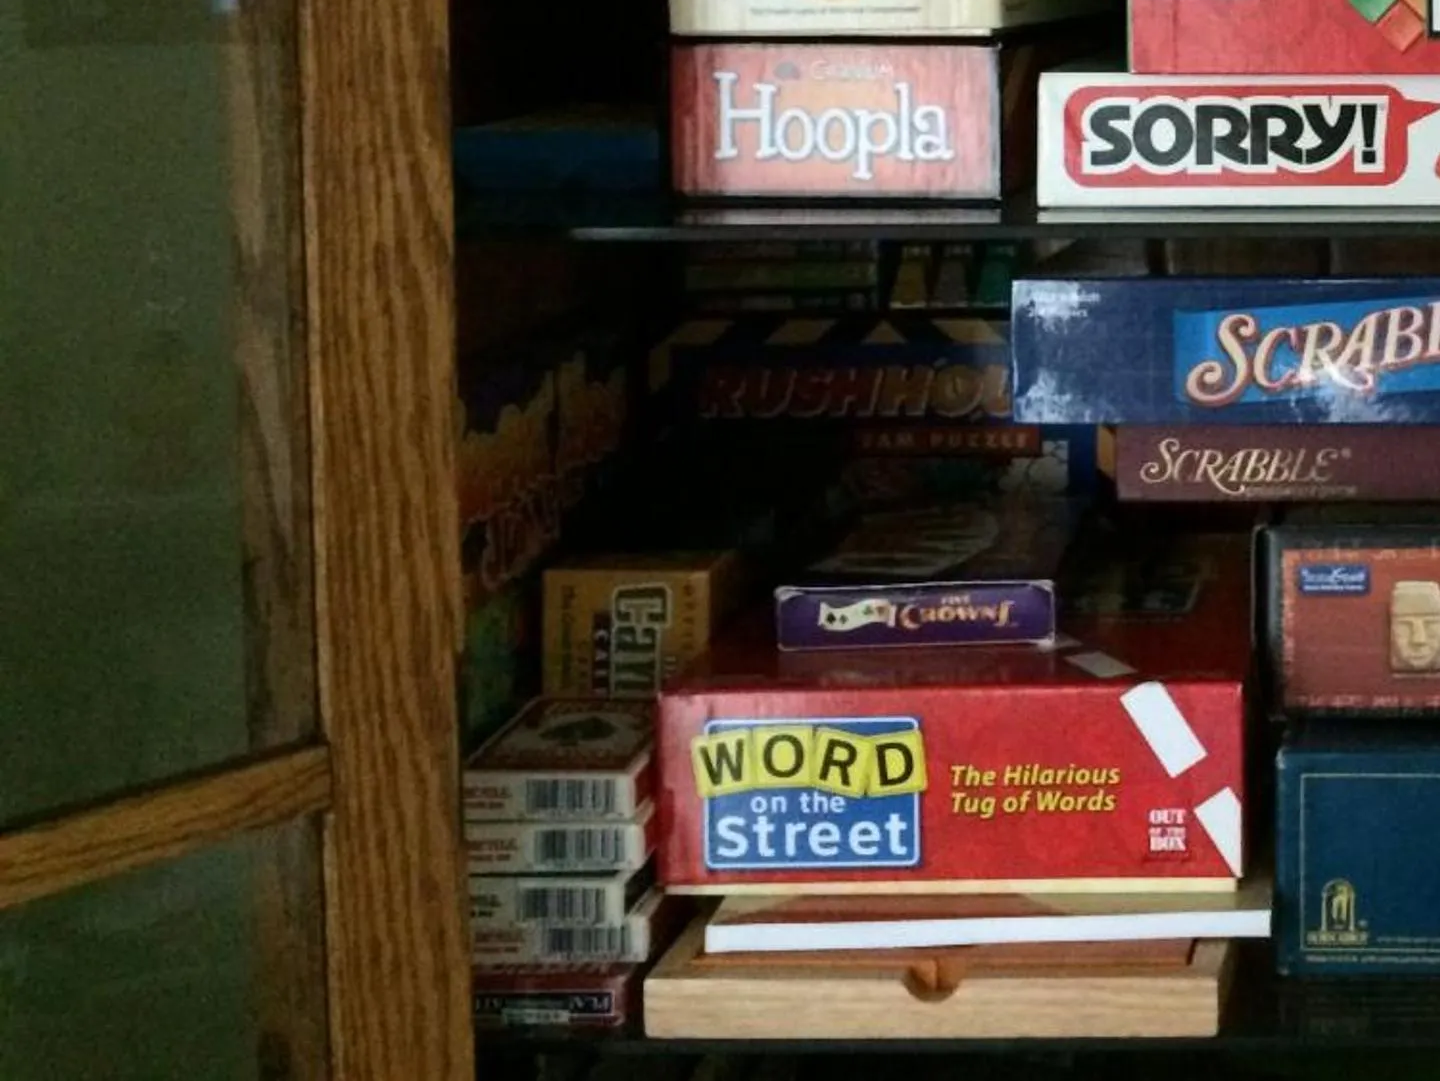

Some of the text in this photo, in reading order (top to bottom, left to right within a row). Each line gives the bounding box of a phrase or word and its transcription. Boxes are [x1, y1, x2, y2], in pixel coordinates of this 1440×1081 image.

[712, 70, 956, 181] Hoopla
[1087, 101, 1379, 167] SORRY!
[697, 364, 882, 422] RUSH
[928, 430, 1029, 450] PUZZLE
[1140, 436, 1339, 496] SCRABBLE
[898, 599, 1017, 631] CROWNS
[698, 731, 916, 788] WORD
[950, 763, 1121, 787] The Hilarious
[749, 790, 847, 815] on the
[950, 789, 1117, 821] Tug of Words
[1148, 808, 1187, 825] OUT
[715, 814, 910, 859] Street
